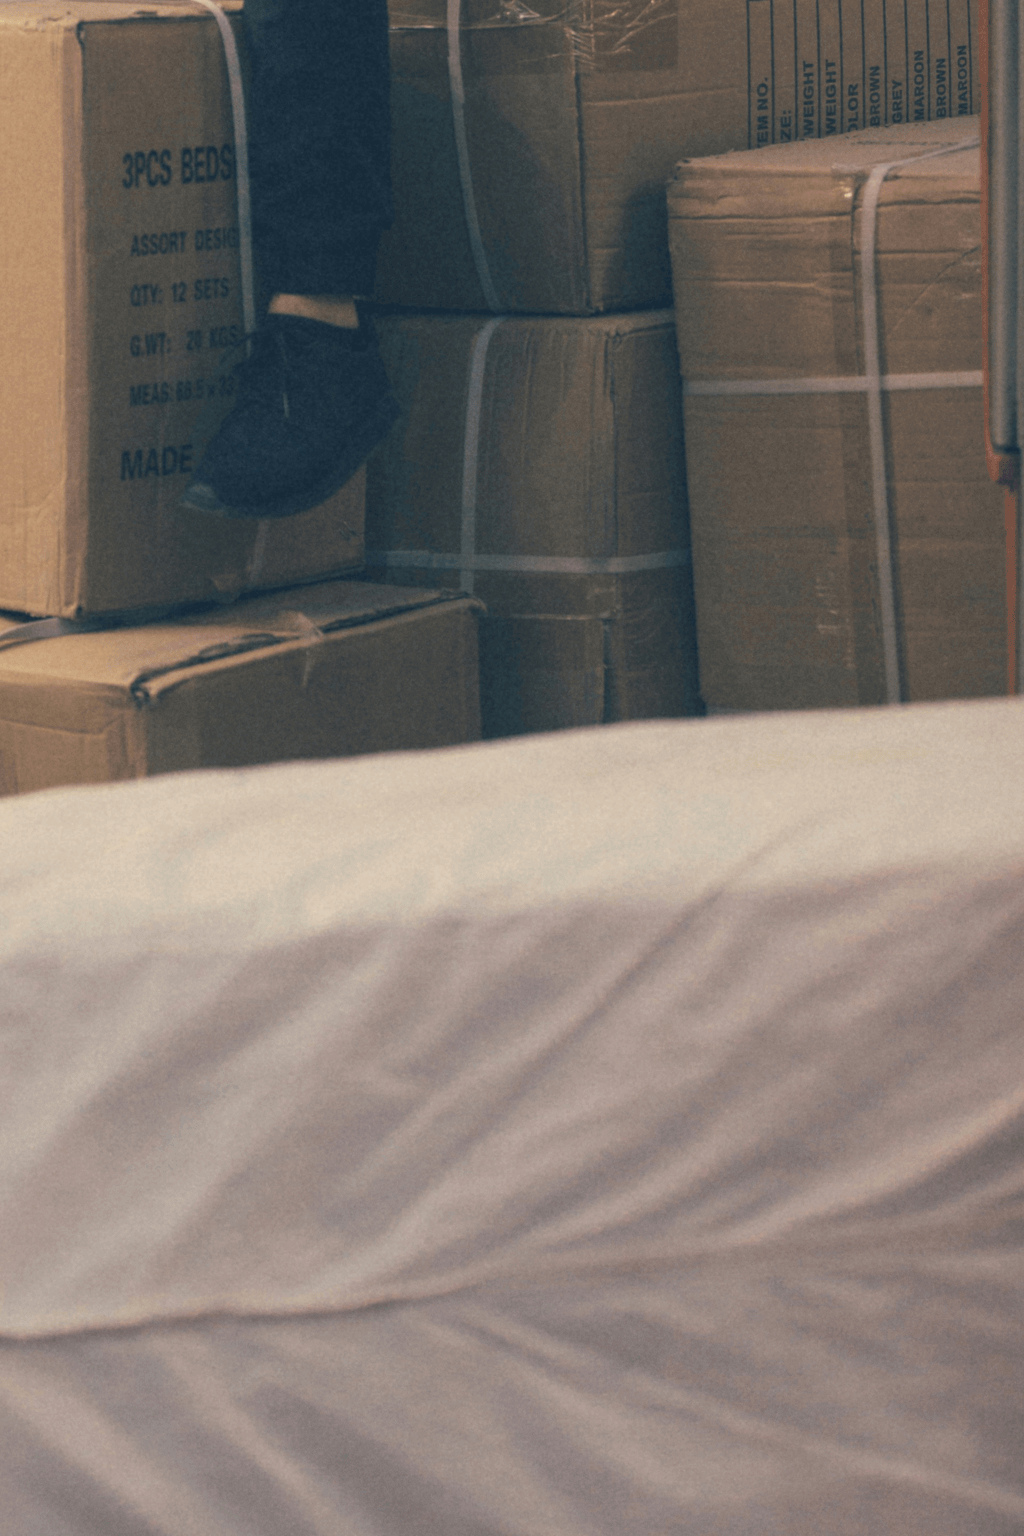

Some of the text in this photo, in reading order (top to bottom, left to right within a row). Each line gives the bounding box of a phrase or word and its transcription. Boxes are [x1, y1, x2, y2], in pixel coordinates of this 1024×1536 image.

[757, 77, 769, 110] NO.
[869, 65, 881, 127] BROWN
[913, 50, 925, 121] MAROON
[936, 57, 947, 118] BROWN
[957, 45, 968, 115] MAROON
[891, 79, 903, 124] GREY
[757, 115, 769, 148] EM
[122, 148, 172, 189] 3PCS
[130, 230, 188, 257] ASSORT
[130, 277, 229, 307] QTY: 12 SETS
[130, 331, 171, 357] G.WT:
[120, 444, 193, 480] MADE
